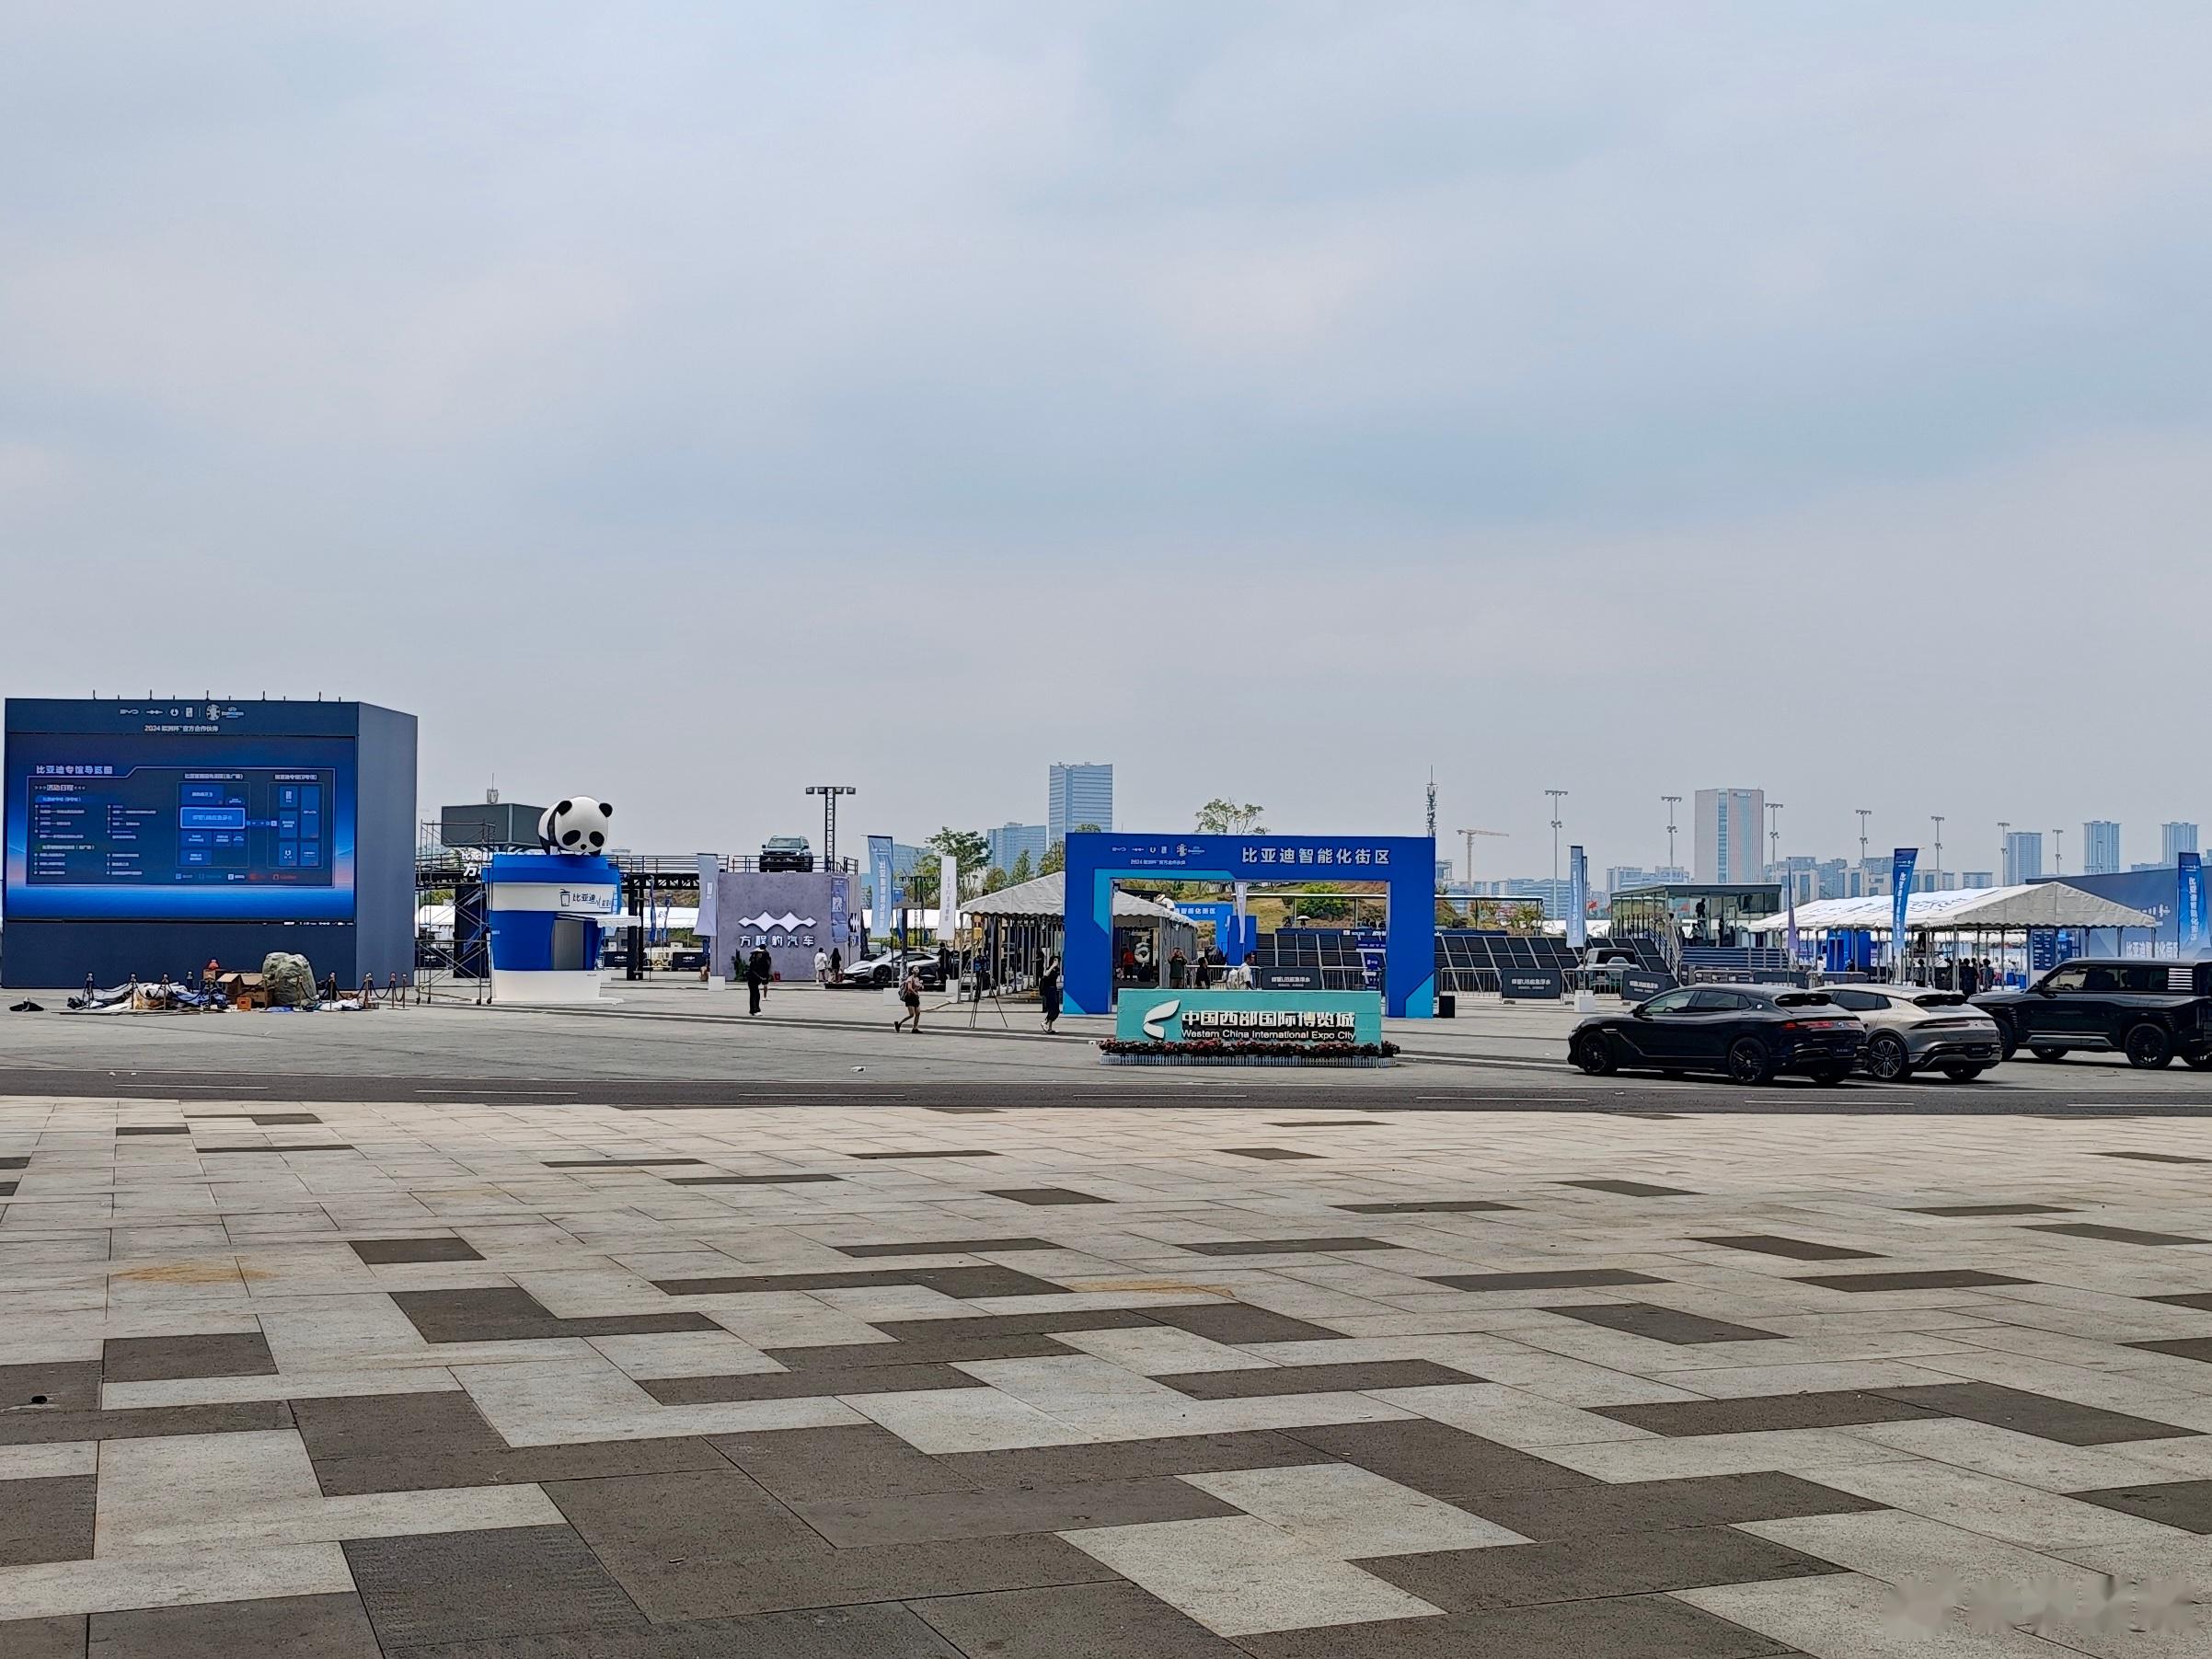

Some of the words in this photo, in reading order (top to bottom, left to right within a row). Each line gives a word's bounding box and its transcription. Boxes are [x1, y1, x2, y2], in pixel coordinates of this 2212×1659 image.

[1241, 847, 1390, 865] 比亚迪智能化街区
[572, 893, 596, 903] 比亚迪
[739, 935, 814, 947] 方程豹汽车
[1181, 1010, 1355, 1027] 中国西部国际博览城
[1181, 1030, 1220, 1038] Western
[1222, 1030, 1250, 1038] China
[1251, 1030, 1309, 1039] International
[1311, 1031, 1335, 1041] Expo
[1337, 1031, 1356, 1042] City
